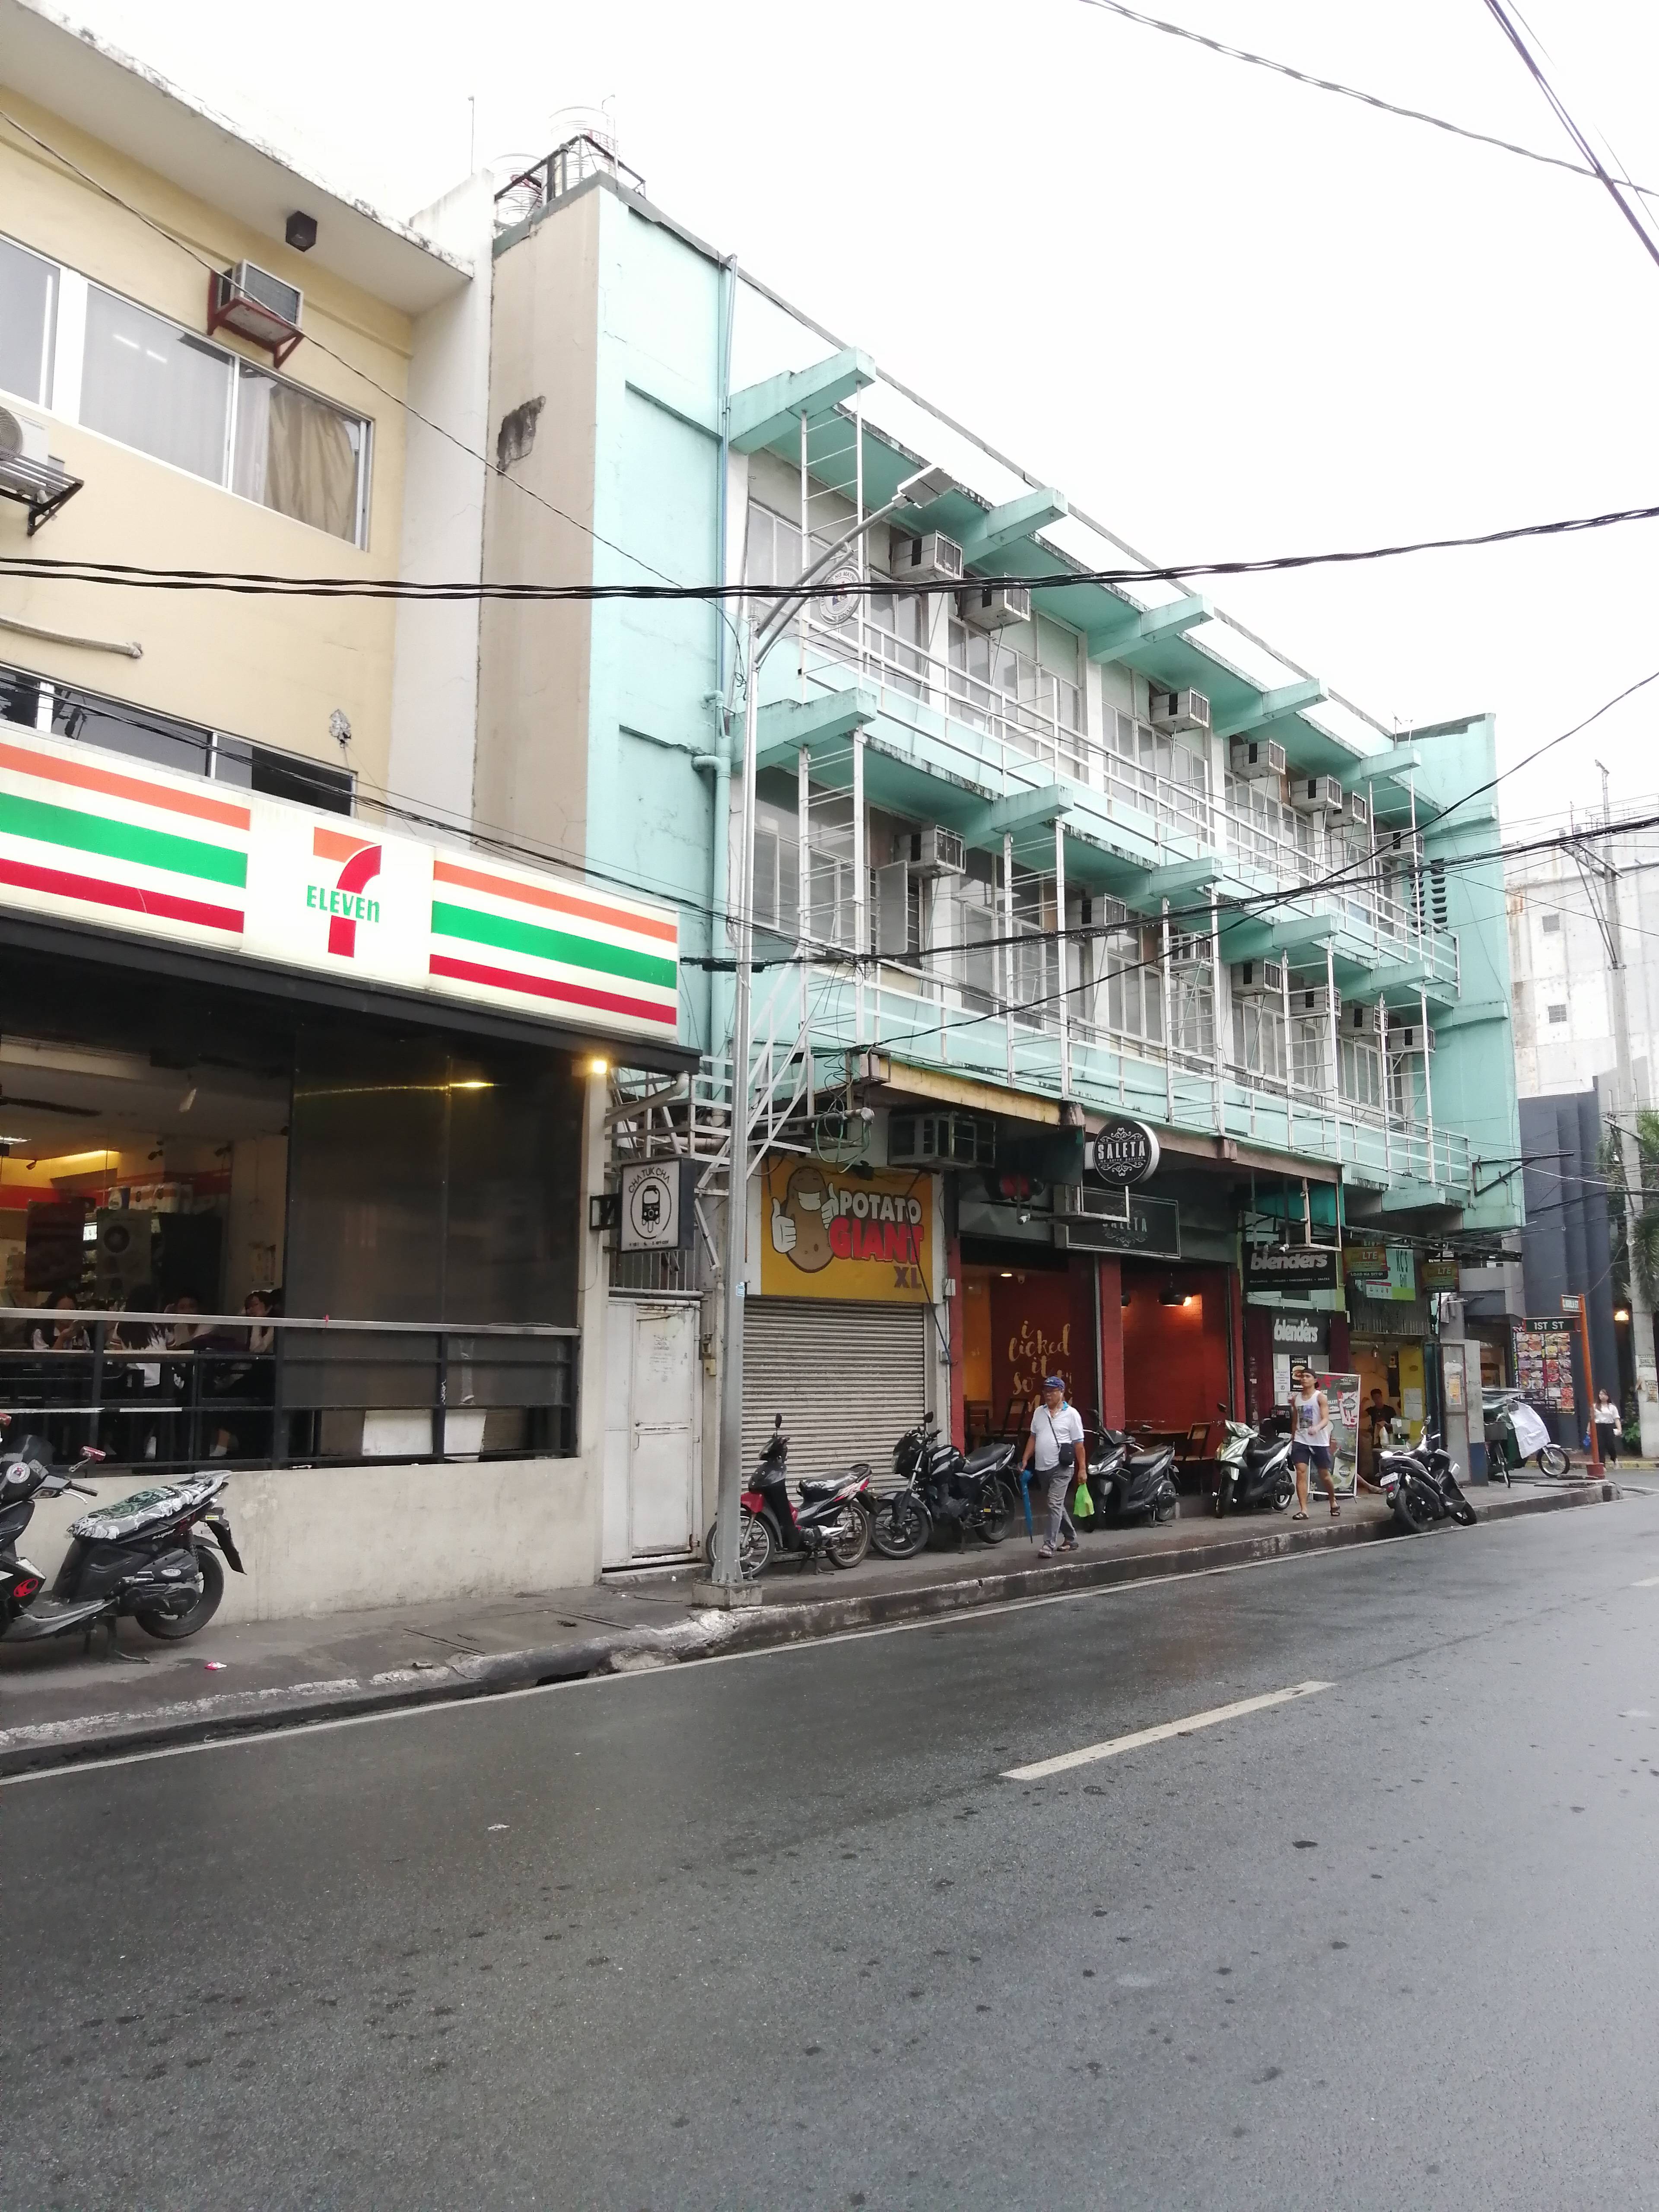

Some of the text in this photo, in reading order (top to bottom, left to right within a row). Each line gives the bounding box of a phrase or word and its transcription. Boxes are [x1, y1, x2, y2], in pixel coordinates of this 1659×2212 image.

[1098, 1141, 1145, 1160] SALETA
[629, 1167, 670, 1193] CHA TUK CHA
[839, 1189, 922, 1224] POTATO
[829, 1215, 924, 1265] GIANT
[1251, 1252, 1327, 1271] blenders
[1362, 1251, 1377, 1259] LTE
[894, 1266, 922, 1288] XL
[1274, 1317, 1318, 1343] blenders
[1534, 1321, 1548, 1330] 1ST
[1552, 1321, 1564, 1330] ST
[1008, 1323, 1070, 1362] licked
[1031, 1355, 1051, 1378] it
